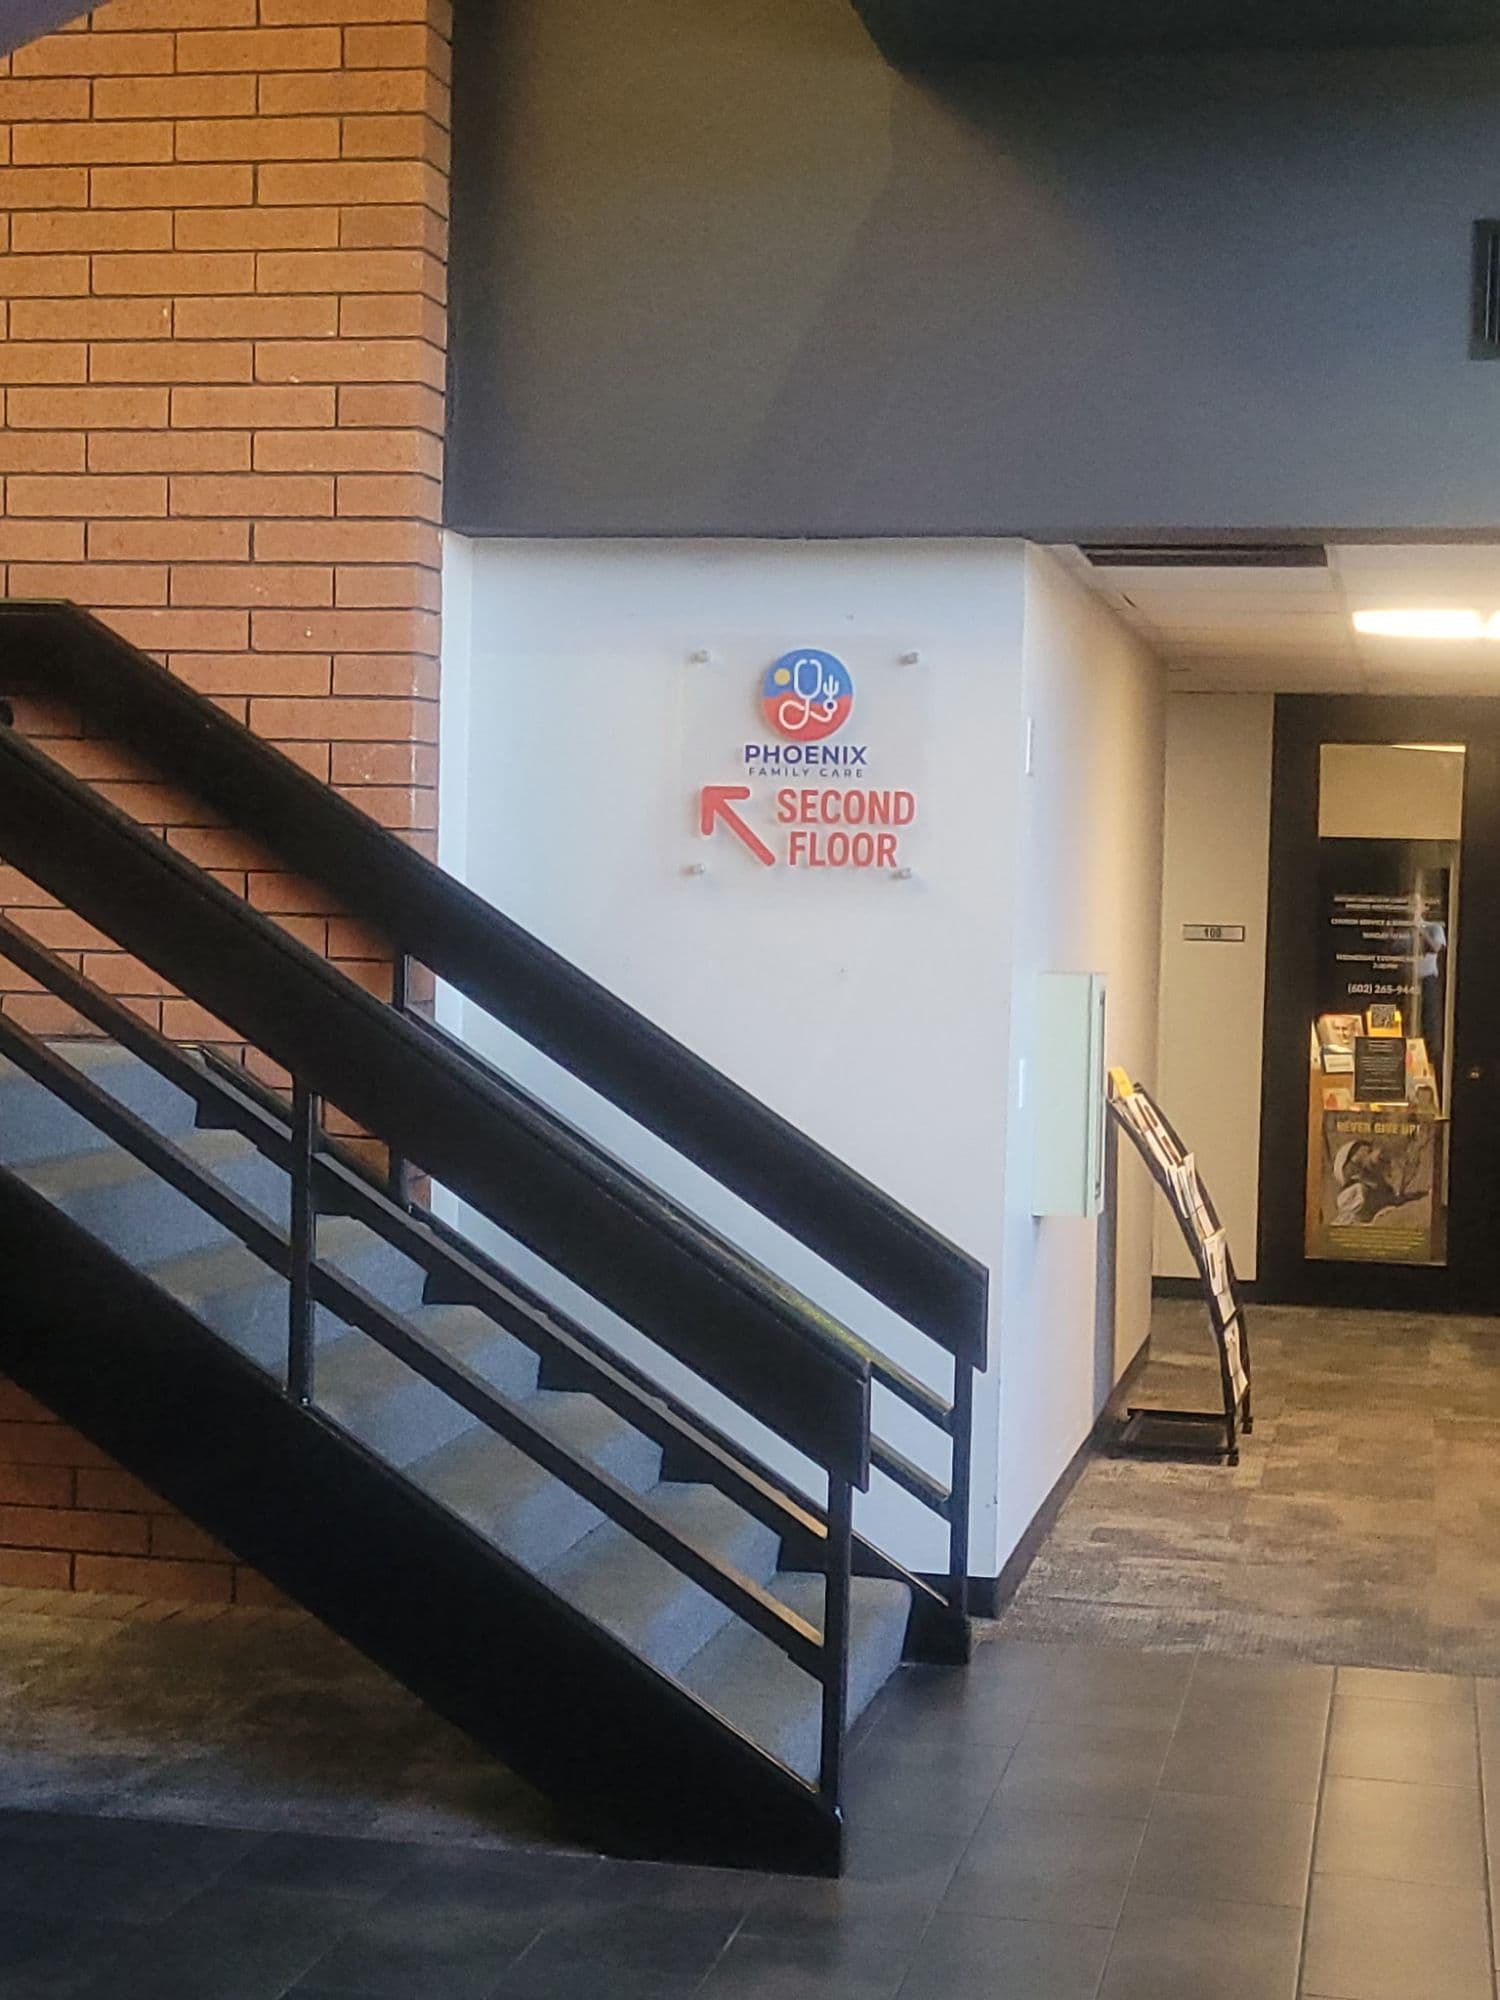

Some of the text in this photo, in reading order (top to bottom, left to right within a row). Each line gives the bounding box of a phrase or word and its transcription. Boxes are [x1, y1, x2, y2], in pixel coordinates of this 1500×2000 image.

[744, 745, 868, 765] PHOENIX
[749, 767, 864, 778] FAMILY CARE
[777, 788, 916, 825] SECOND
[789, 831, 898, 868] FLOOR
[1347, 983, 1373, 994] (602)
